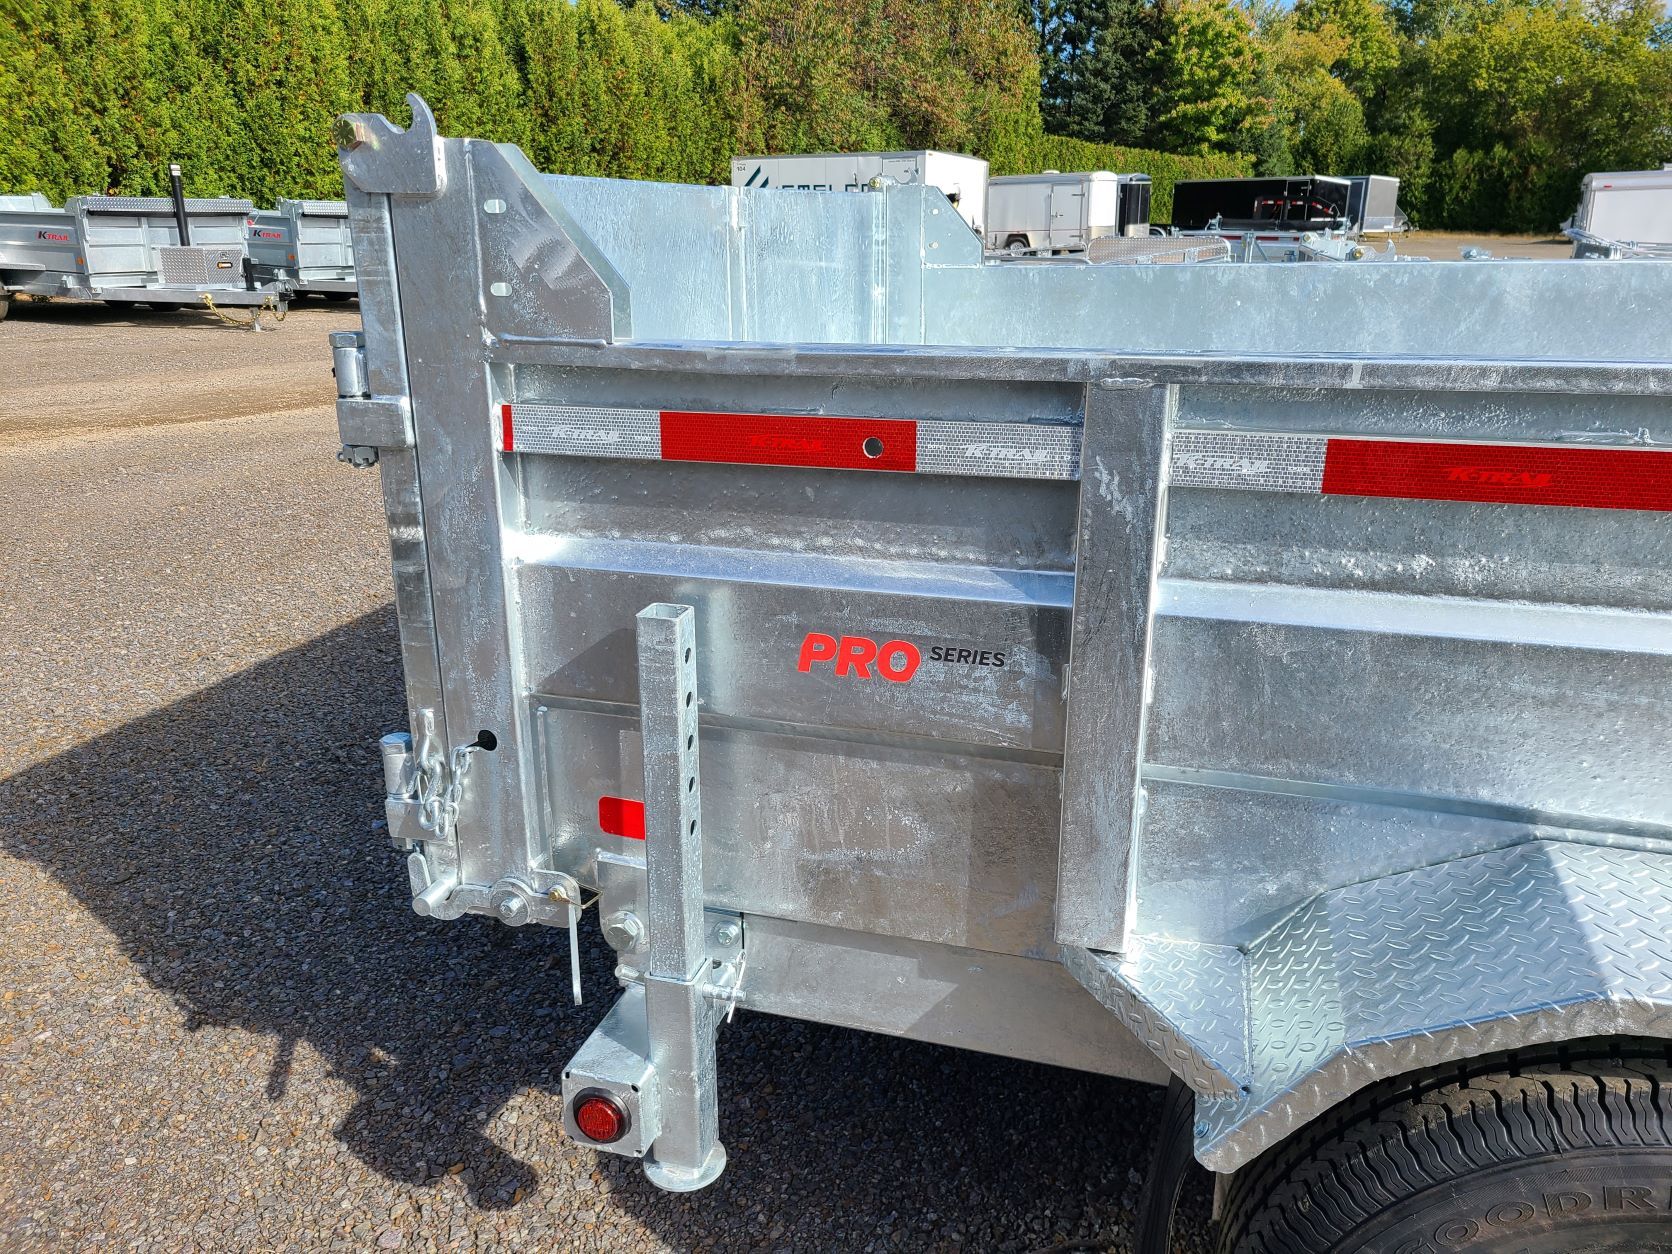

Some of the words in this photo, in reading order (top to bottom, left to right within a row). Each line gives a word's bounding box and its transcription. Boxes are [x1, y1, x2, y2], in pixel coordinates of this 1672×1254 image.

[797, 632, 922, 683] PRO
[930, 645, 1006, 667] SERIES
[1395, 1185, 1672, 1254] GOODR
